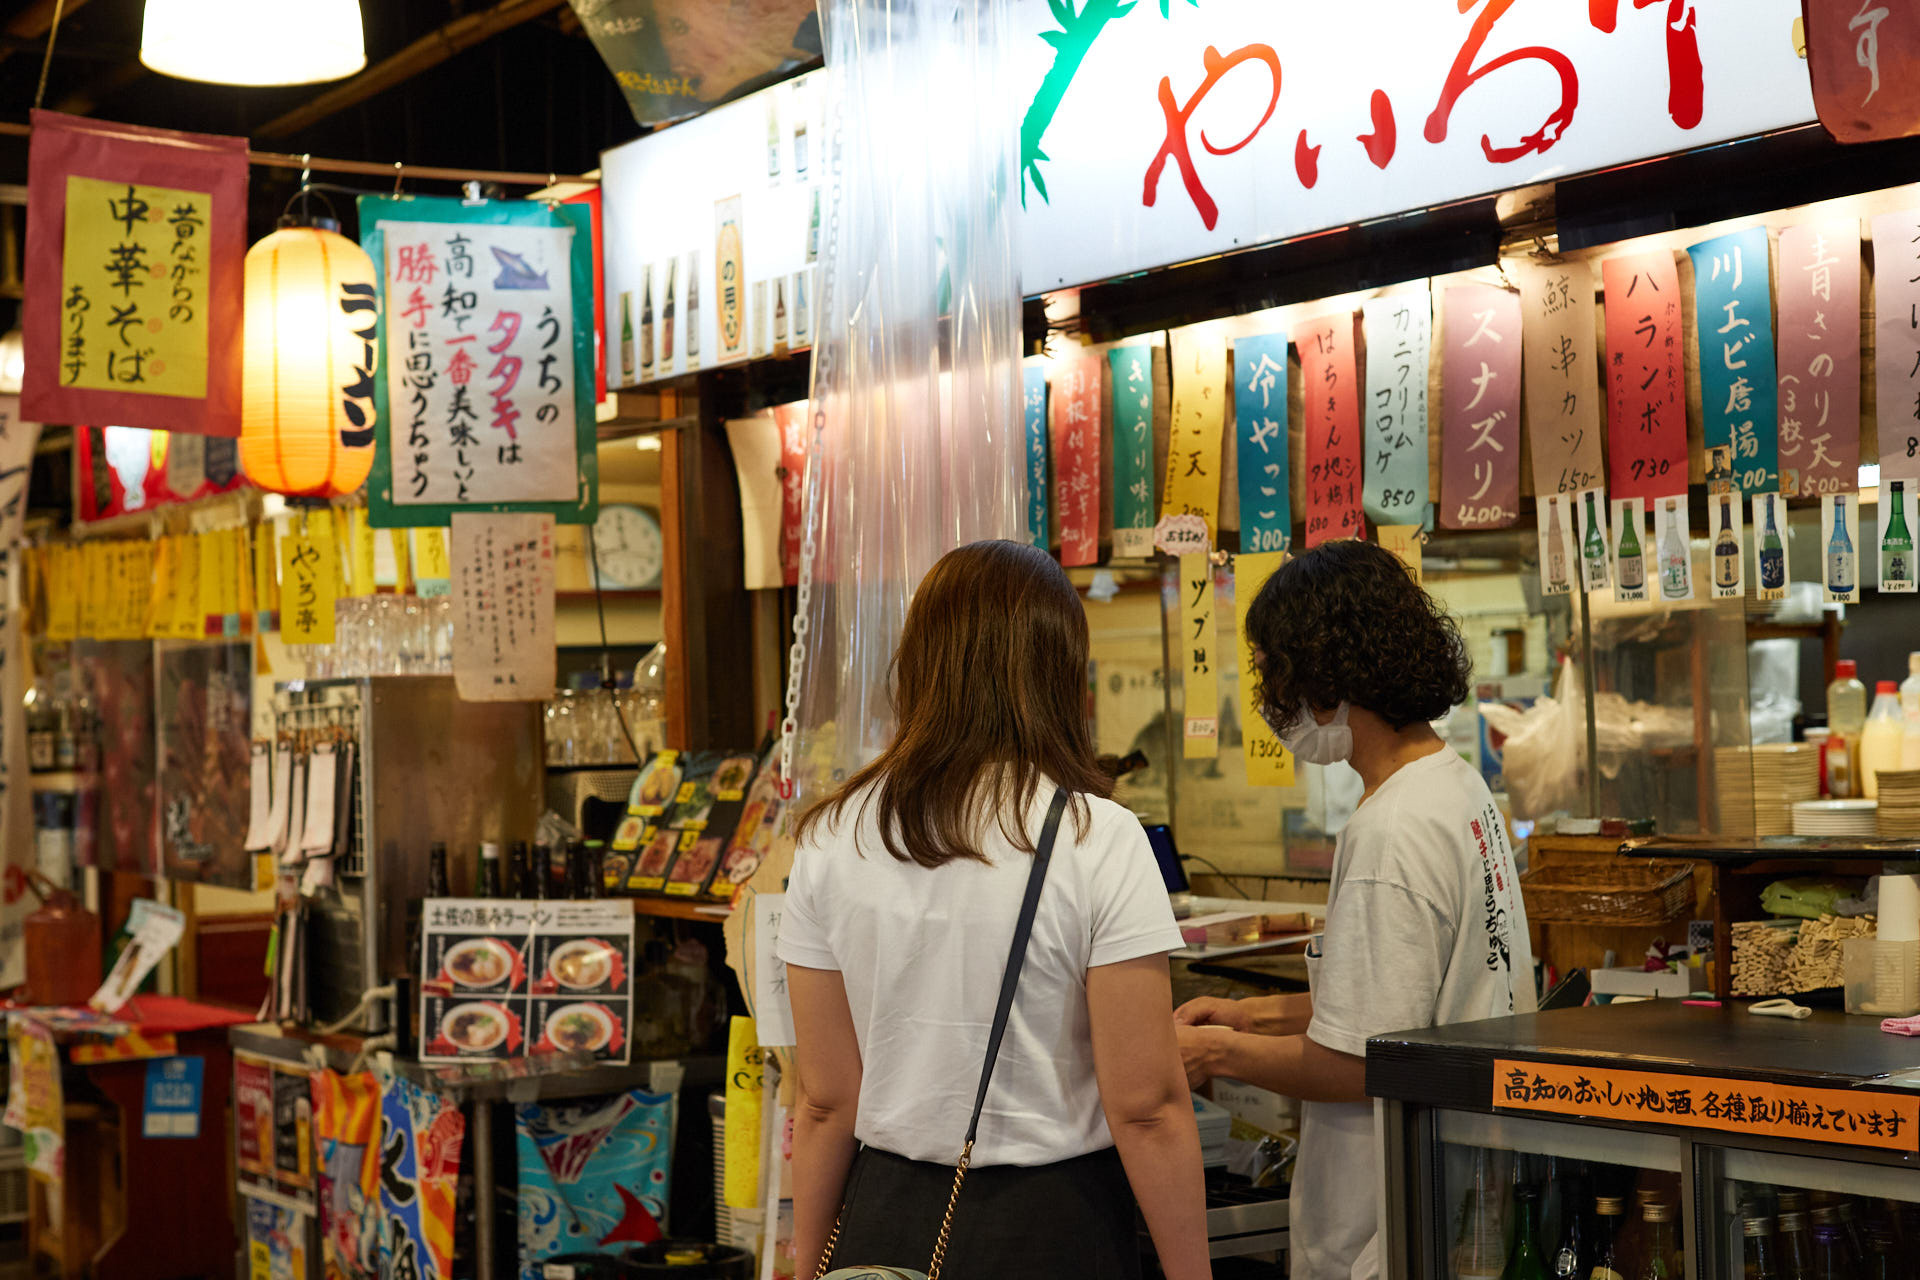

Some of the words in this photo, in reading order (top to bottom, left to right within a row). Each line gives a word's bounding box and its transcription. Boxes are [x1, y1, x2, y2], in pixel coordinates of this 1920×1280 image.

[105, 185, 150, 384] 中華そば
[168, 204, 204, 323] 昔ながらの
[63, 284, 91, 384] あります
[487, 310, 524, 465] タタキは
[535, 305, 563, 425] うちの
[1393, 309, 1413, 449] カニクリーム
[1541, 274, 1584, 458] 鯨串カツ
[1626, 271, 1663, 434] ハランボ
[1710, 245, 1759, 460] 川エビ唐揚
[1803, 233, 1842, 470] 青さのり天
[1248, 352, 1283, 520] 冷やっこ
[1375, 387, 1394, 474] コロッケ
[1463, 308, 1507, 501] スナズリ
[1630, 458, 1670, 482] 730
[1380, 488, 1416, 508] 850
[291, 542, 320, 635] やいろ亭
[1191, 578, 1209, 675] ツブ貝
